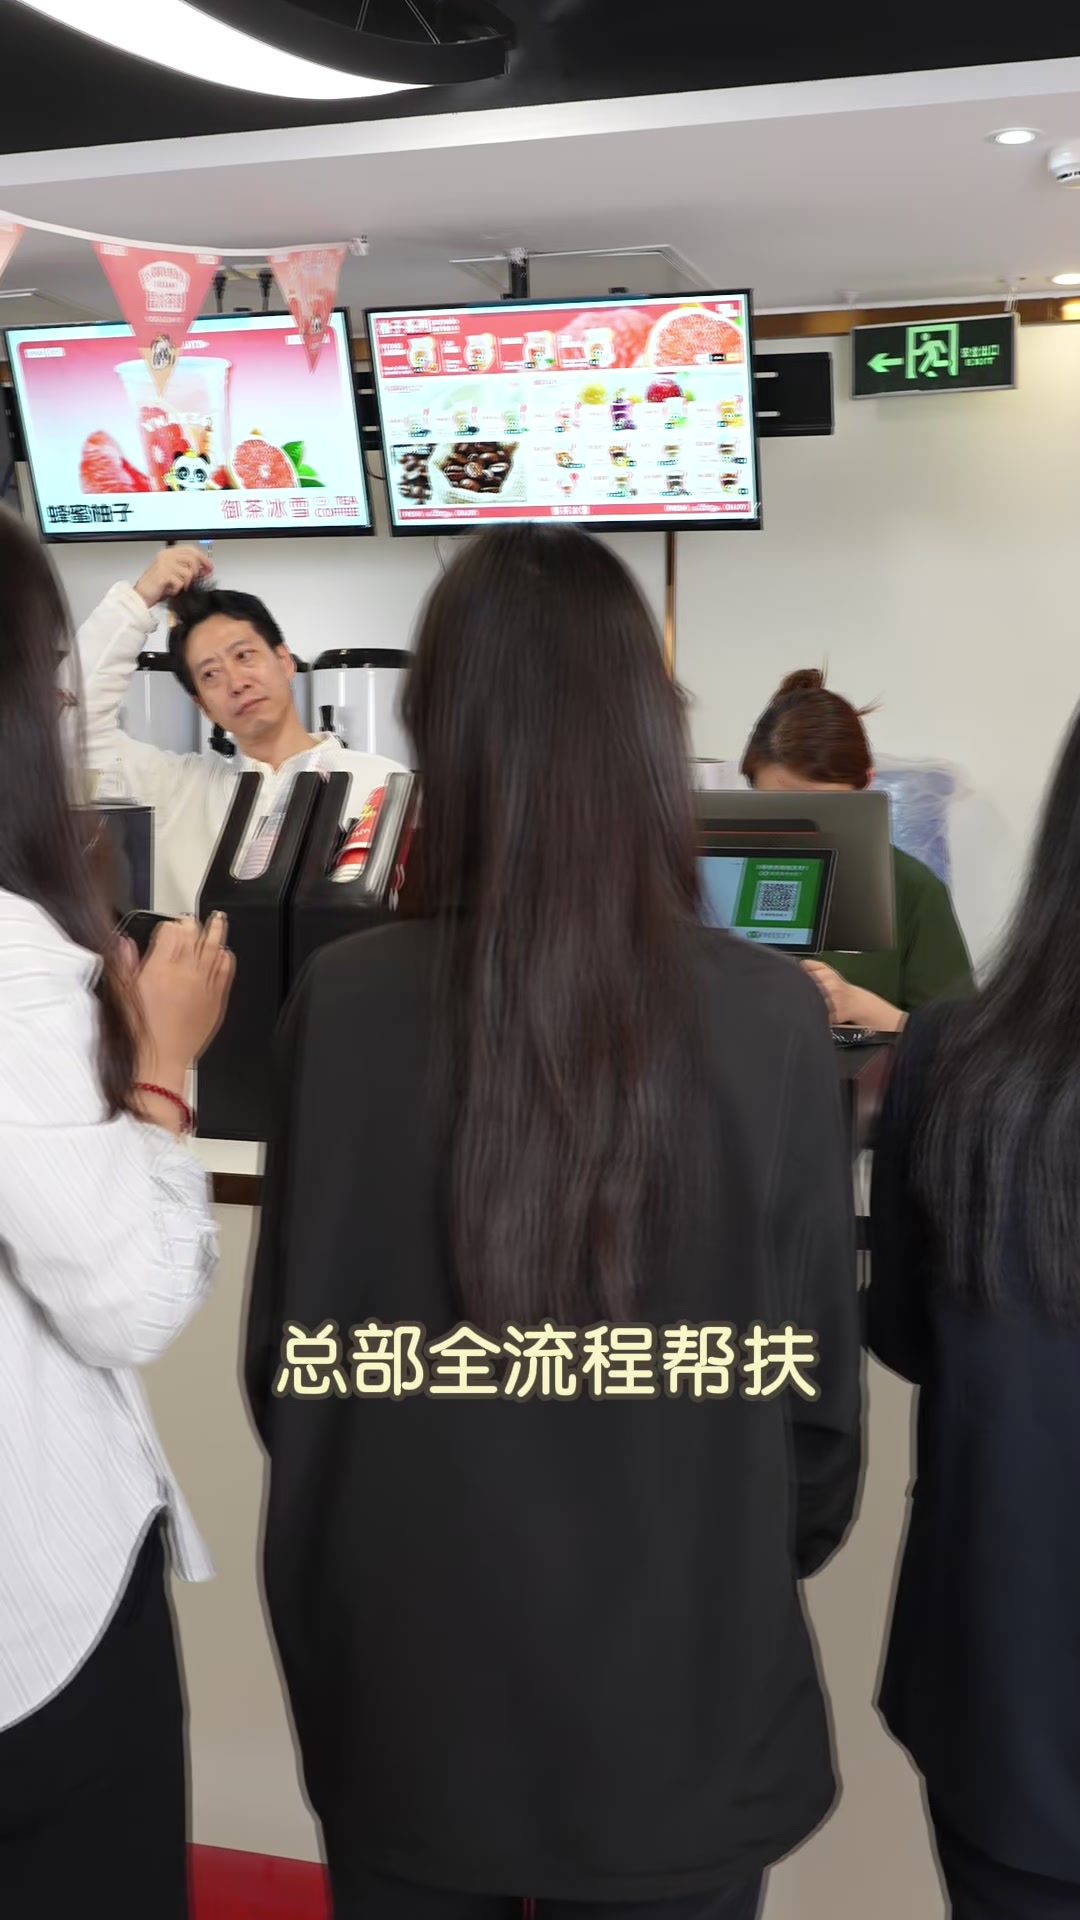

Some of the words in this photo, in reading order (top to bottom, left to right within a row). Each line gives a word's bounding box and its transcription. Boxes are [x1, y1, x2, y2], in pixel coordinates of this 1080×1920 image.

[47, 503, 134, 523] 蜂蜜柚子
[221, 498, 310, 519] 御茶冰雪
